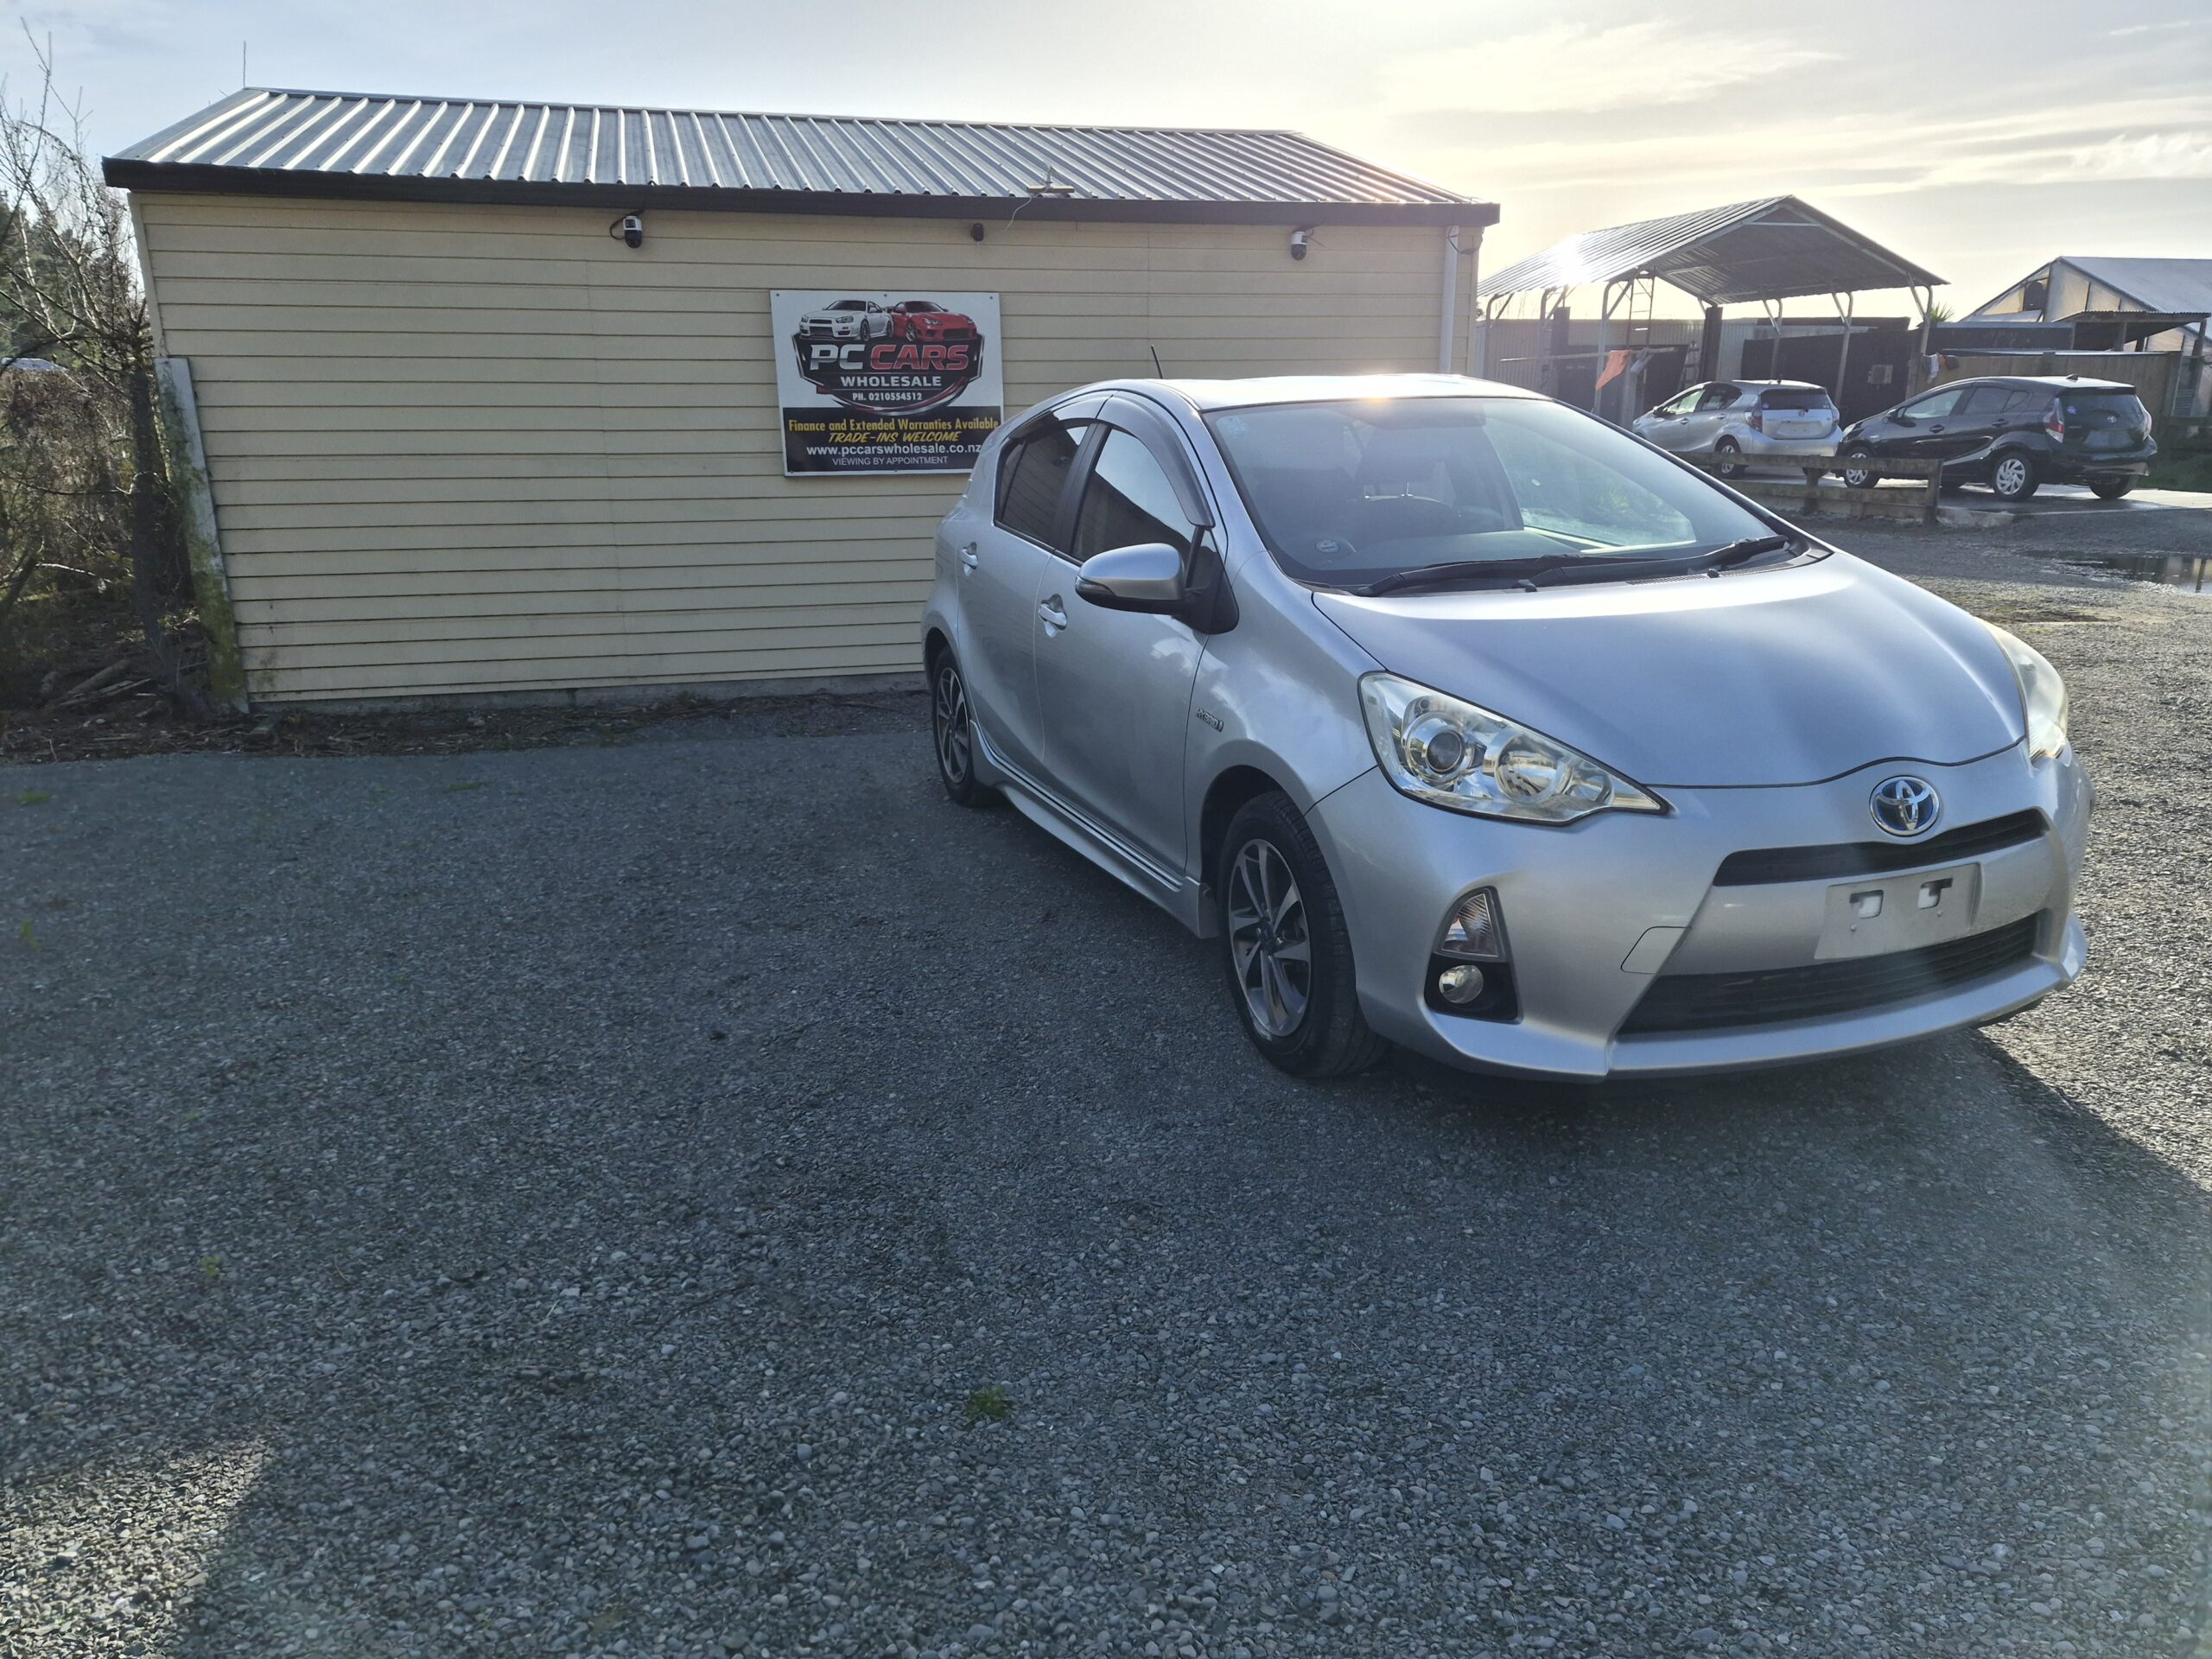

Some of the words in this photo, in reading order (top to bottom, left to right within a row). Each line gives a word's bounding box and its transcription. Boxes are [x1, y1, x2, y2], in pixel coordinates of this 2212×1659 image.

[810, 344, 866, 371] PC
[870, 344, 969, 371] CARS
[840, 376, 942, 387] WHOLESALE
[852, 392, 867, 401] PH.
[868, 391, 923, 401] 0210554512
[788, 419, 826, 431] Finance
[829, 418, 847, 430] and
[849, 418, 895, 431] Extended
[898, 418, 952, 430] Warranties
[955, 417, 999, 429] Available
[829, 432, 899, 443] TRADE-INS
[902, 431, 963, 442] WELCOME
[806, 442, 982, 458] www.pccarswholesale.co.nz
[832, 457, 871, 466] VIEWING
[886, 456, 949, 465] APPOINTMENT
